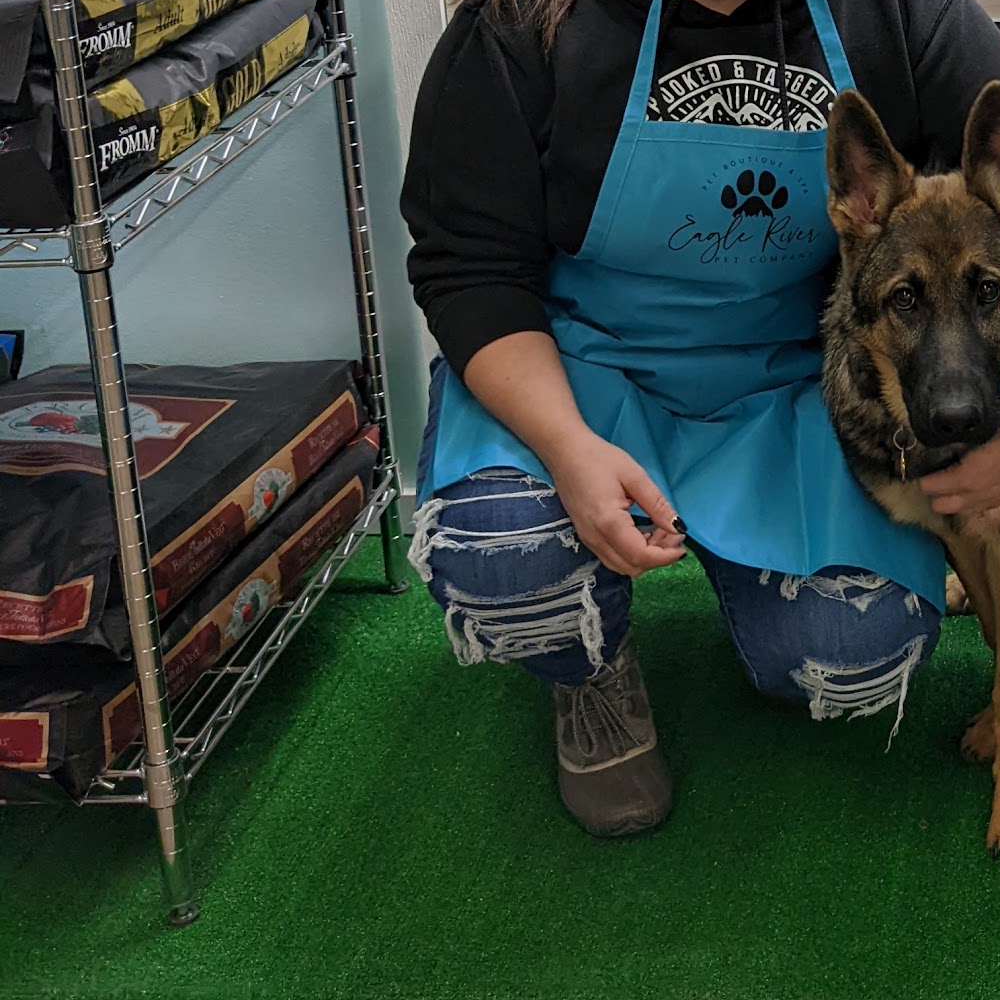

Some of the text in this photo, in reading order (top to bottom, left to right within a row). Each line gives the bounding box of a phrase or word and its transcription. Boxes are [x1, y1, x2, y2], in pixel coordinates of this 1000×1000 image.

[153, 4, 185, 34] Adult
[78, 21, 134, 59] FROMM
[222, 58, 263, 114] GOLD
[733, 61, 744, 79] &
[755, 63, 829, 105] TAGGED
[98, 126, 158, 172] FROMM
[722, 156, 783, 171] BOUTIQUE
[667, 214, 821, 264] Eagle River
[714, 252, 815, 264] PET COMPANY
